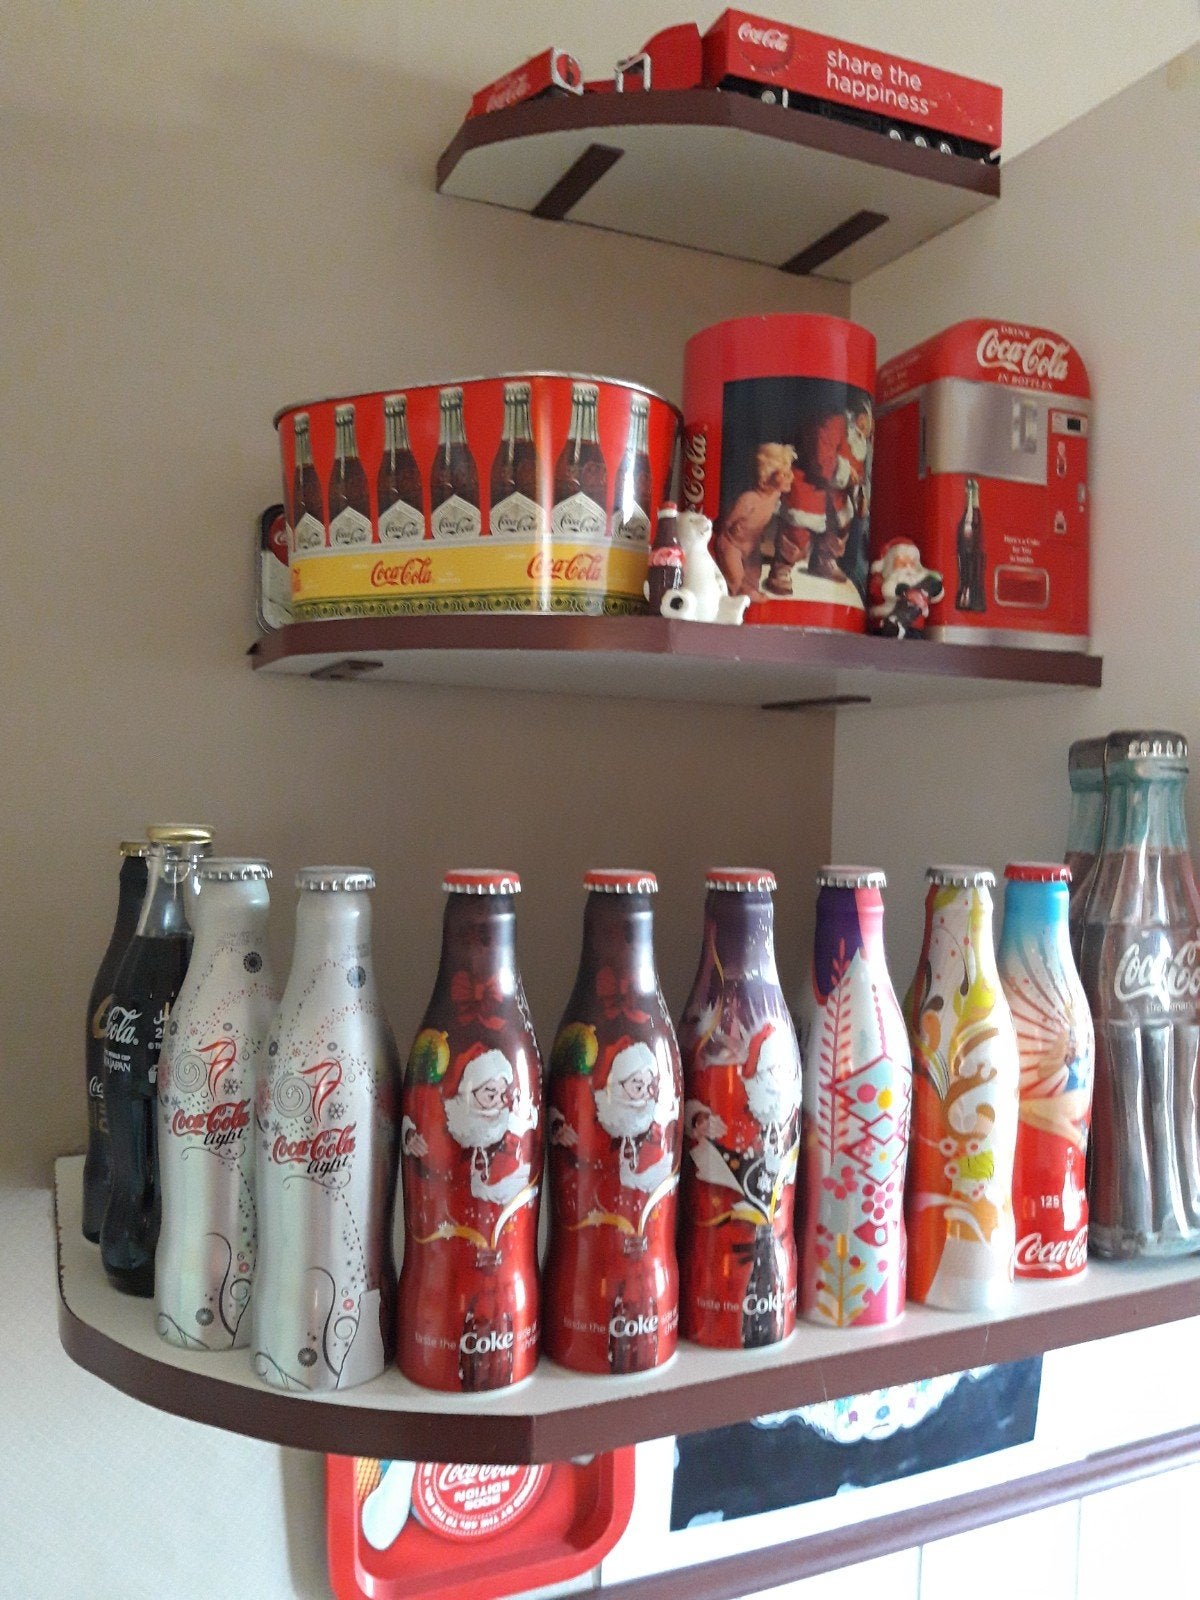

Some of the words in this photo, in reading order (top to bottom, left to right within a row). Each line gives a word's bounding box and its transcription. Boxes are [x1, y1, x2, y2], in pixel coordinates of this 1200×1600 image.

[827, 48, 882, 81] share
[889, 64, 922, 91] the
[826, 67, 930, 116] happiness
[204, 1128, 243, 1149] light
[307, 1155, 348, 1178] light
[609, 1314, 659, 1338] Coke
[459, 1331, 514, 1354] Coke
